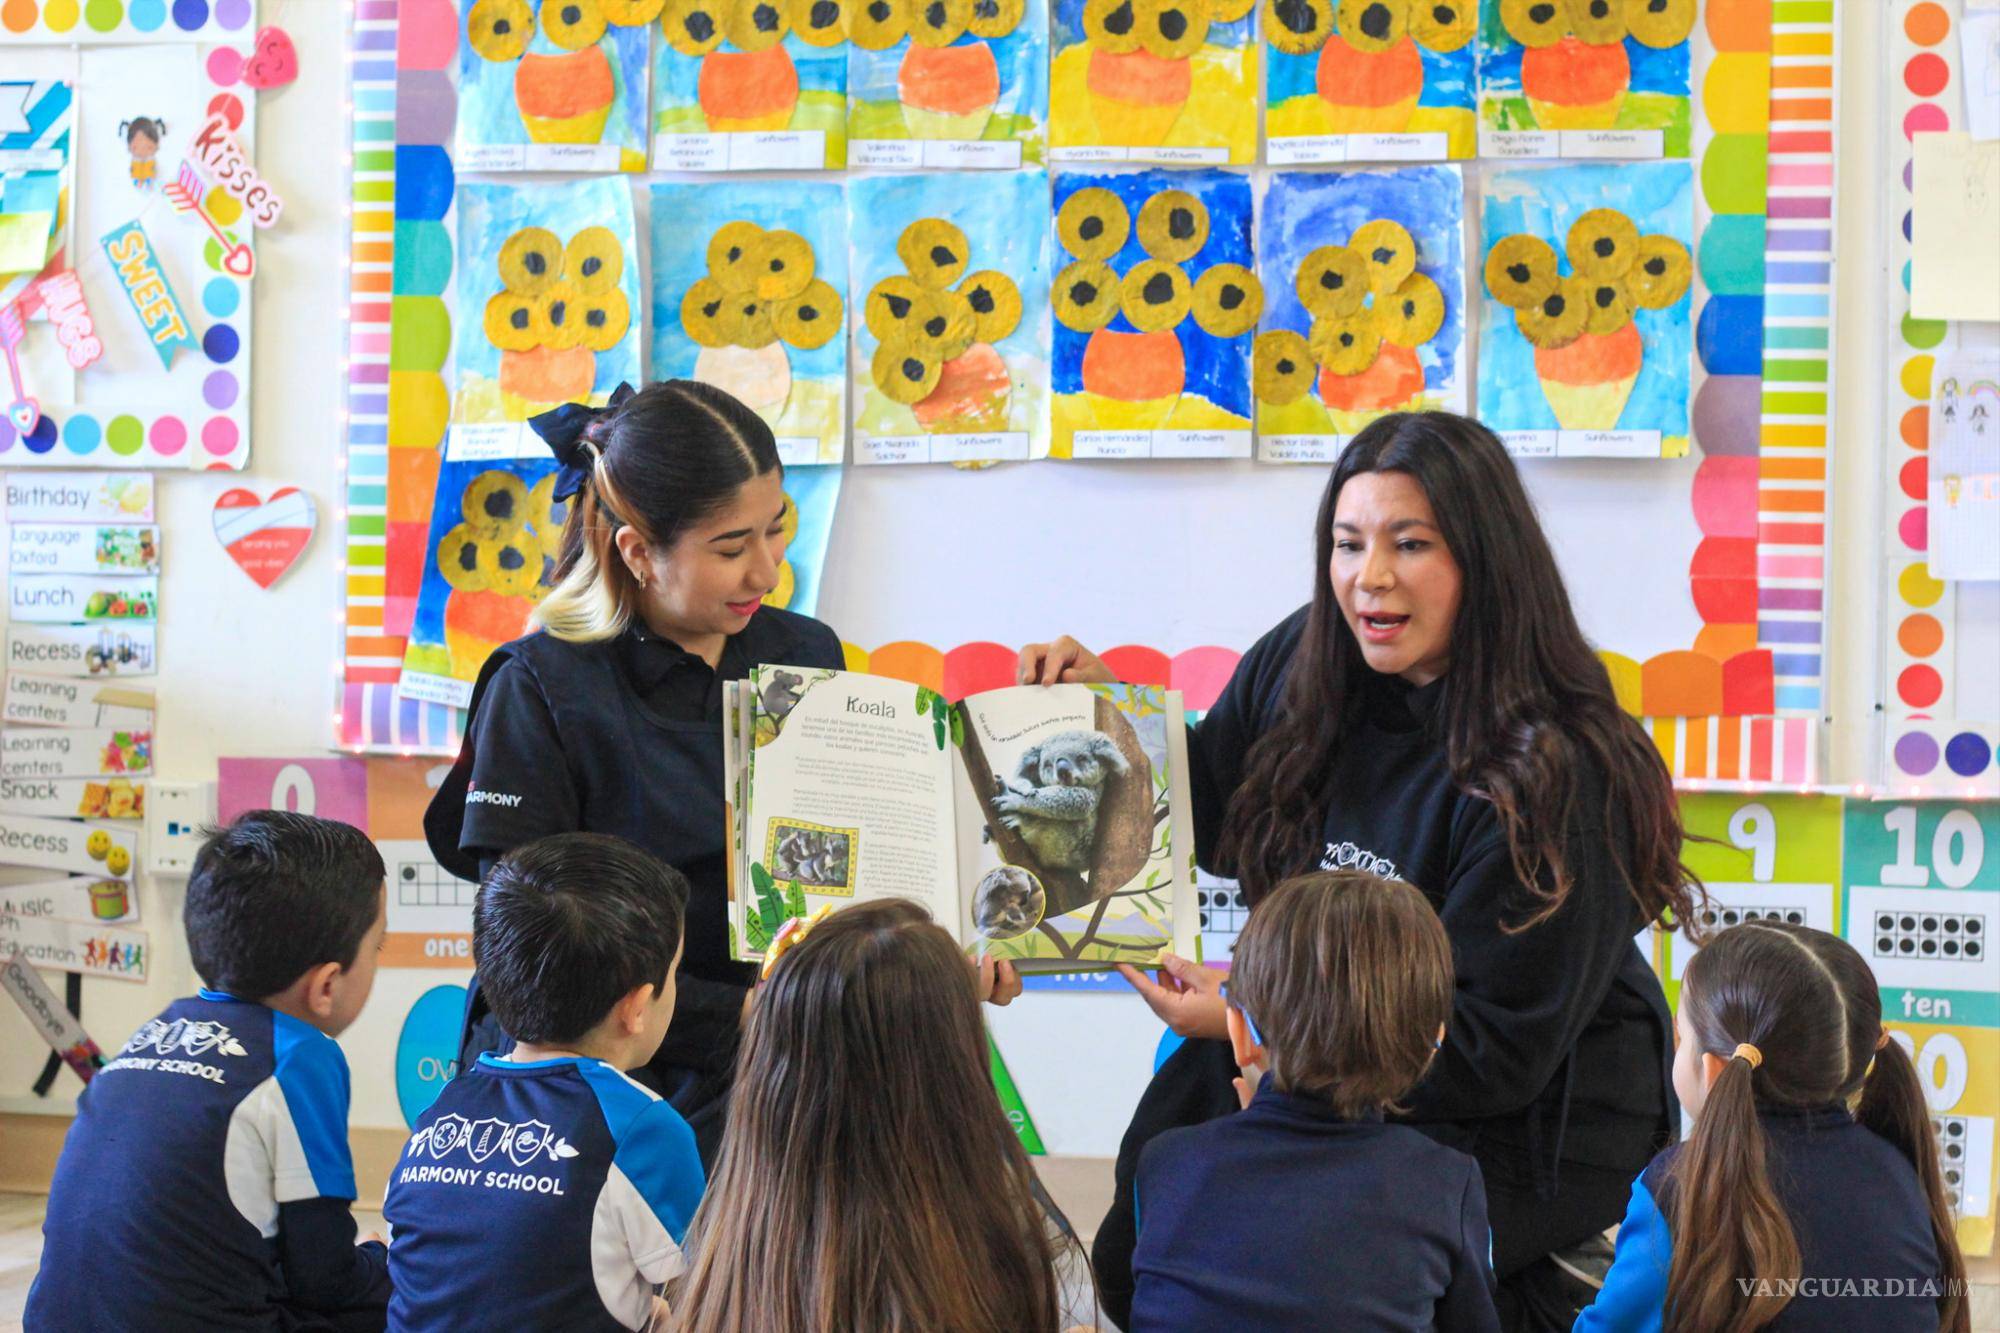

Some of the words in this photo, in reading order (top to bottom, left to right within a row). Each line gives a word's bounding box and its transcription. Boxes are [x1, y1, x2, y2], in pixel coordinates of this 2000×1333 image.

[109, 230, 186, 342] SWEET
[6, 485, 90, 508] Birthday
[11, 529, 80, 544] Language
[10, 551, 58, 565] Oxford
[13, 587, 74, 606] Lunch
[12, 641, 81, 661] Recess
[10, 677, 77, 700] Learning
[7, 703, 67, 722] centers
[846, 695, 896, 719] Koala
[2, 735, 70, 754] Learning
[2, 758, 63, 774] centers
[1, 780, 58, 800] Snack
[465, 790, 522, 807] ARMONY
[1728, 803, 1776, 882] 9
[1880, 806, 1984, 889] 10
[424, 938, 469, 958] one
[1900, 990, 1952, 1019] ten
[157, 1059, 226, 1084] SCHOOL
[400, 1166, 481, 1186] HARMONY
[484, 1171, 564, 1196] SCHOOL
